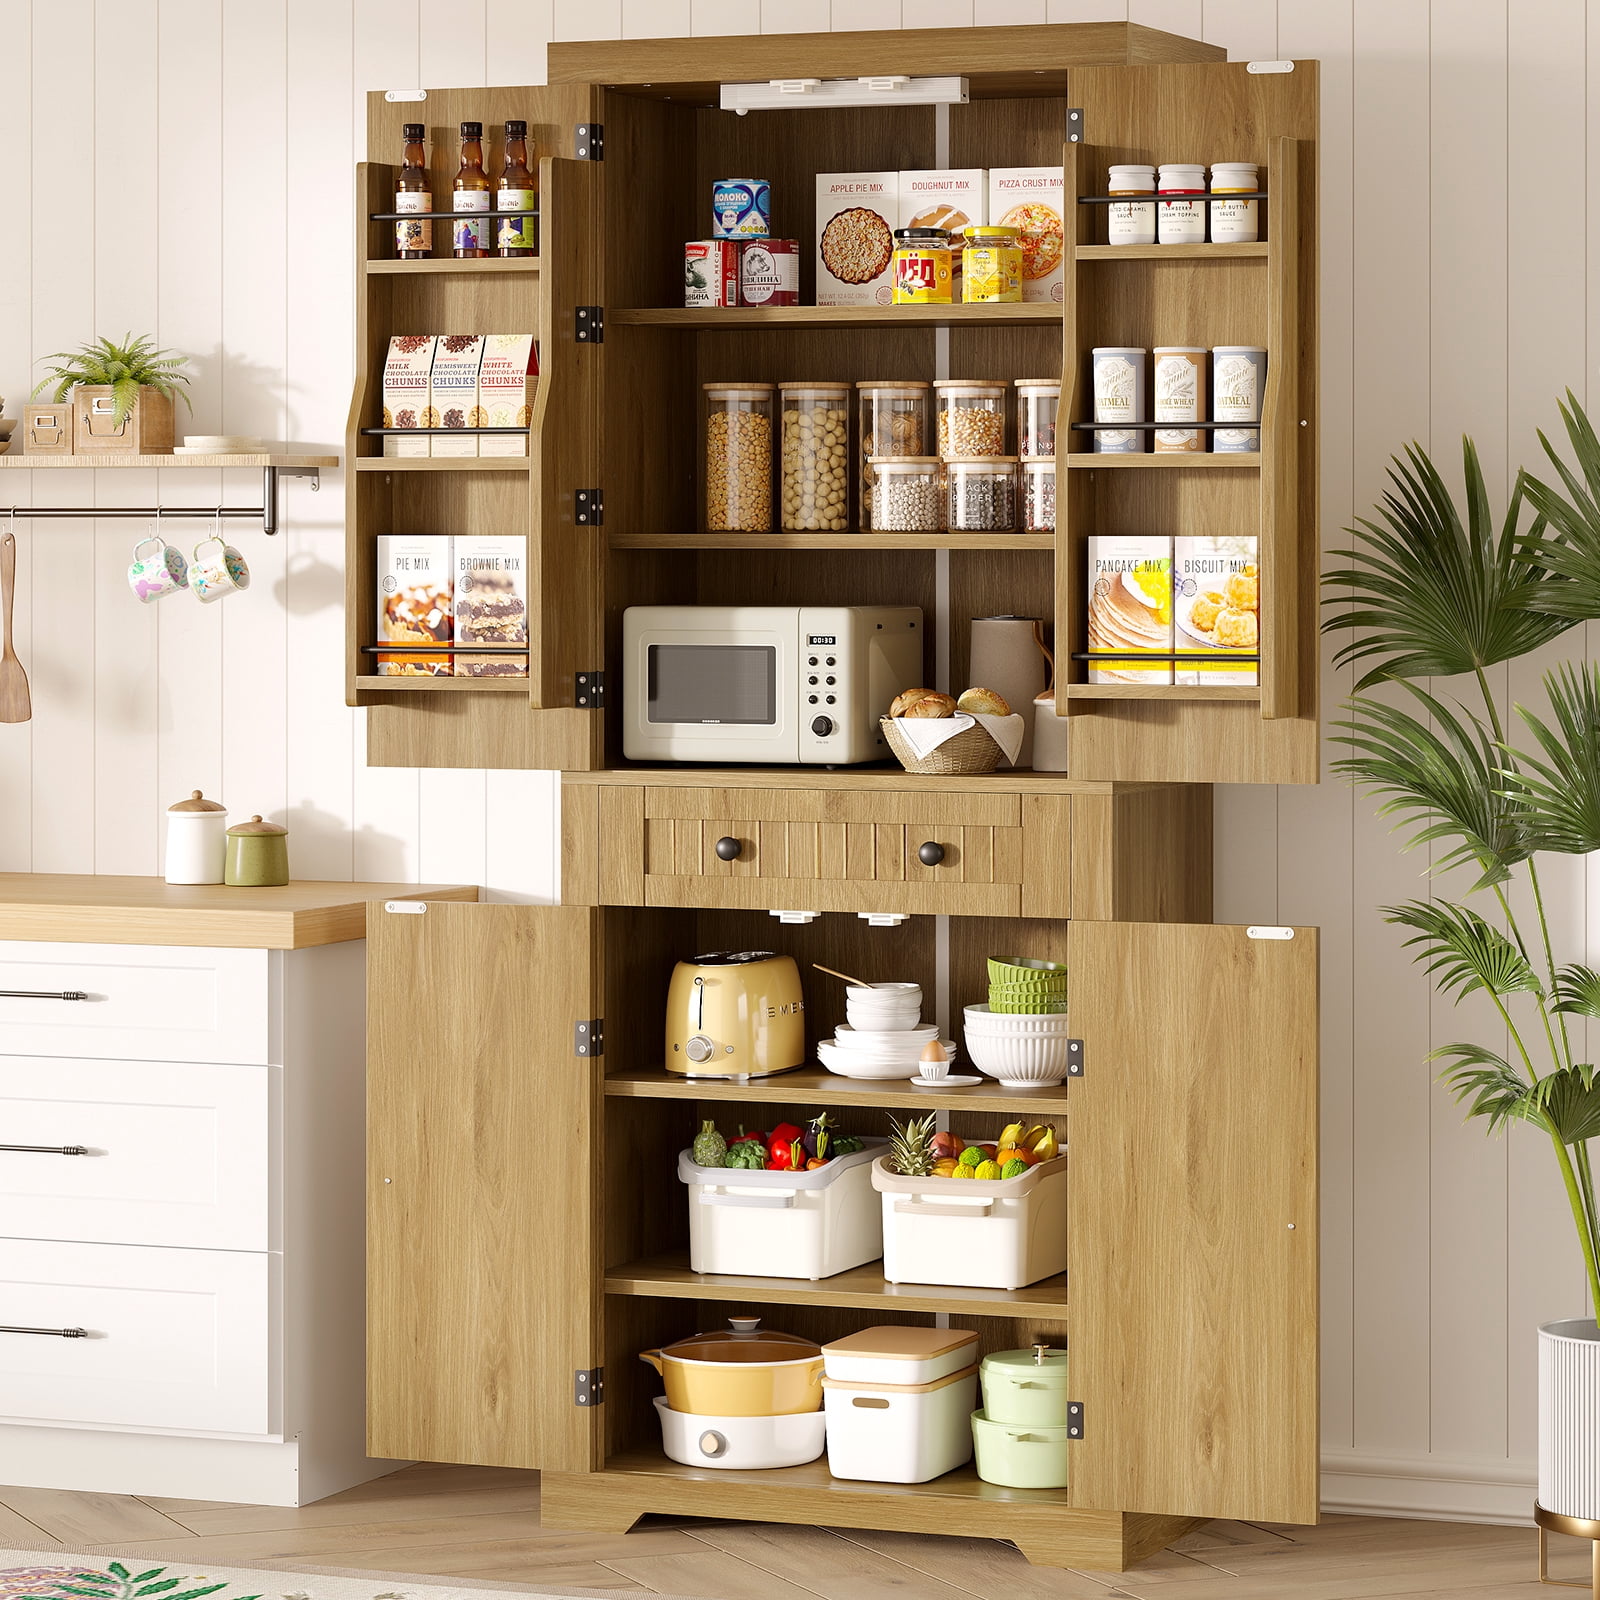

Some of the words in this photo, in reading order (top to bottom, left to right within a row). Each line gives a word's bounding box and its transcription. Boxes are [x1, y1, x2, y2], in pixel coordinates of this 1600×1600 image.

[830, 184, 853, 193] APPLE
[855, 183, 867, 192] PIE
[869, 183, 884, 192] MIX
[912, 181, 953, 190] DOUGHNUT
[955, 181, 970, 189] MIX
[999, 179, 1020, 188] PIZZA
[1022, 178, 1048, 187] CRUST
[1049, 178, 1064, 187] MIX
[384, 377, 428, 386] CHUNKS
[432, 376, 476, 385] CHUNKS
[481, 376, 524, 385] CHUNKS
[1173, 398, 1195, 406] WHEAT
[396, 557, 410, 570] PIE
[414, 557, 430, 570] MIX
[460, 557, 500, 571] BROWNIE
[504, 557, 520, 570] MIX
[1095, 559, 1140, 573] PANCAKE
[1144, 559, 1162, 573] MIX
[1184, 559, 1225, 573] BISCUIT
[1229, 559, 1248, 573] MIX
